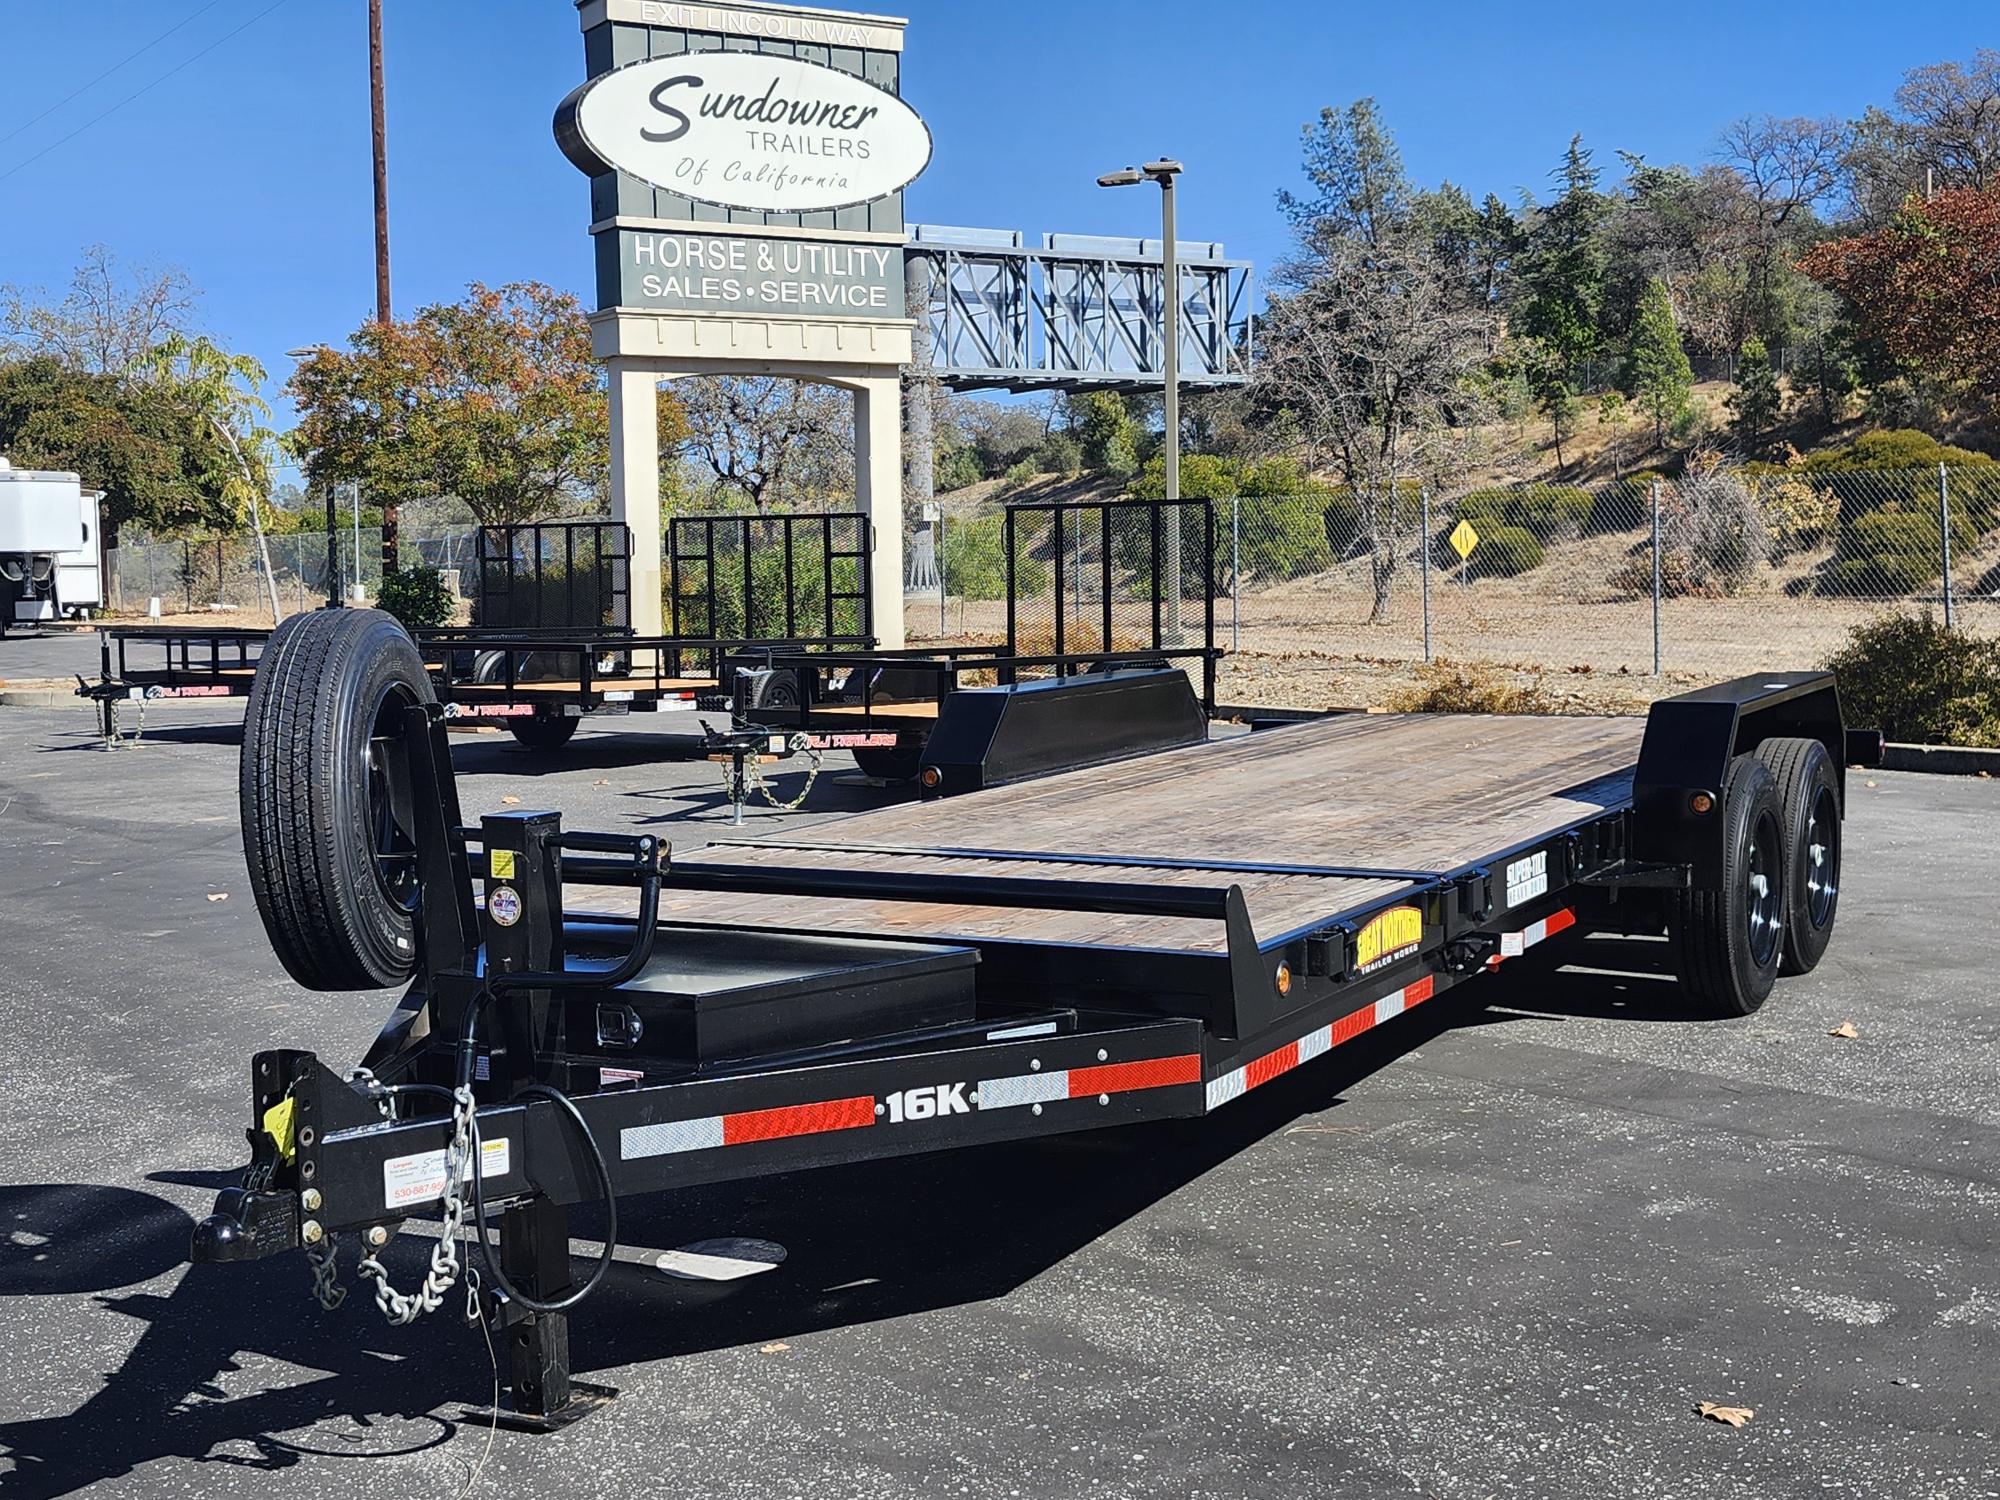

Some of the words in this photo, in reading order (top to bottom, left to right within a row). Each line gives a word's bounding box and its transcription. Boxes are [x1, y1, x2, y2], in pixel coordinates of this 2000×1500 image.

[641, 2, 698, 27] EXIT
[707, 9, 817, 42] LINCOLN
[822, 24, 875, 47] WAY
[640, 75, 879, 143] Sundowner
[746, 131, 871, 159] TRAILERS
[675, 157, 709, 186] Of
[723, 160, 848, 191] California
[634, 234, 747, 271] HORSE
[757, 243, 776, 268] &
[784, 243, 891, 278] UTILITY
[886, 1082, 970, 1123] 16K
